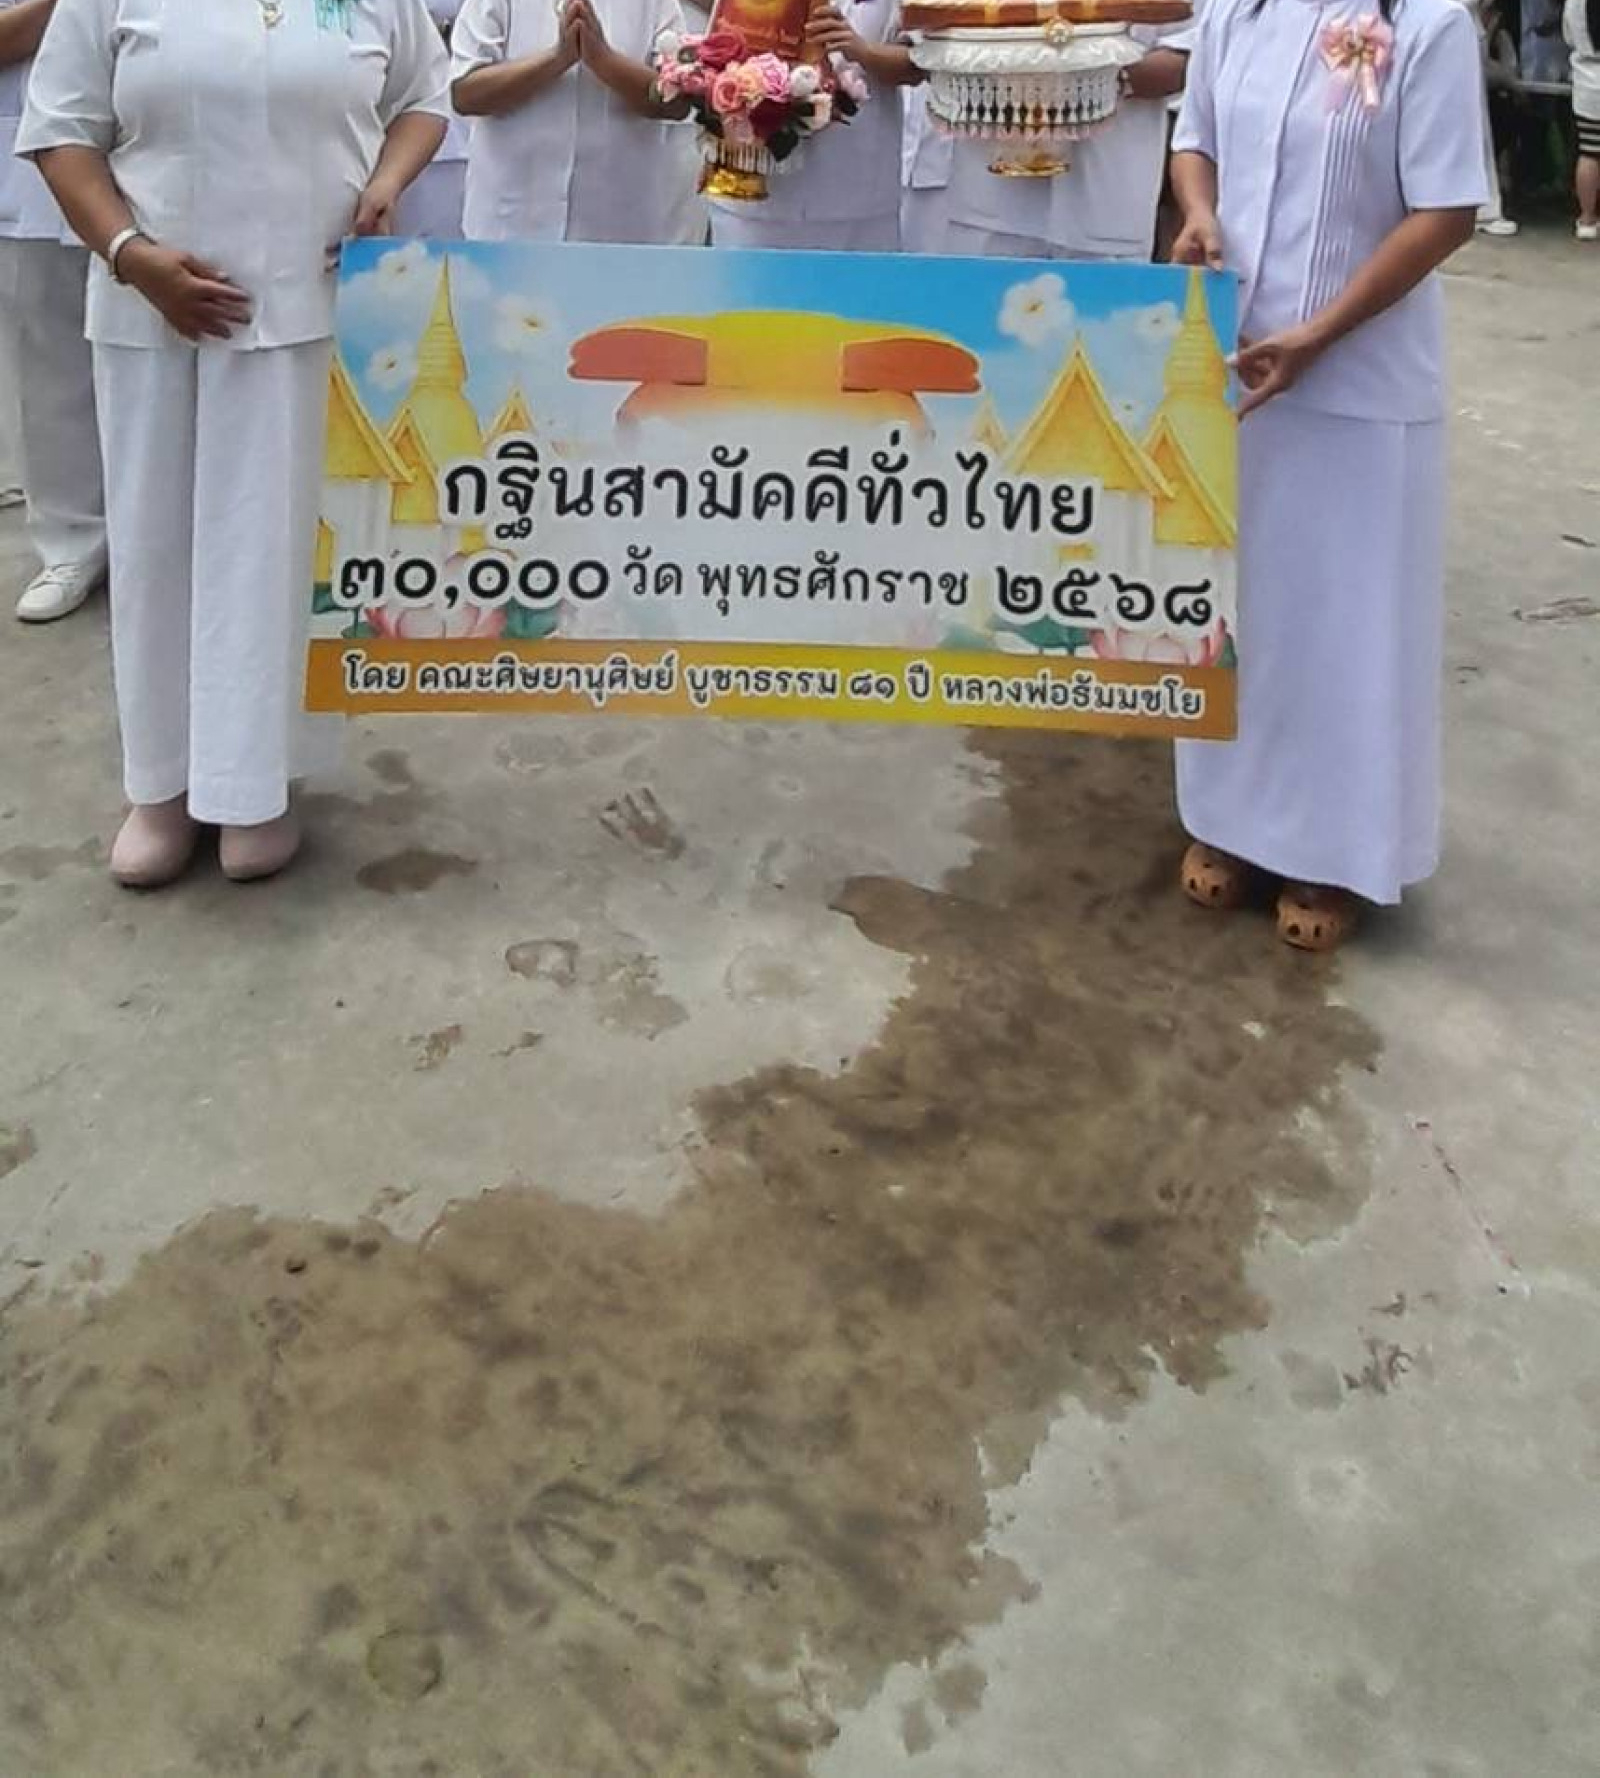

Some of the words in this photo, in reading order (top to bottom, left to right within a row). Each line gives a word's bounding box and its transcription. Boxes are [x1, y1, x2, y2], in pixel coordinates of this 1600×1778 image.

[445, 429, 1094, 540] กฐินสามัคคีทั่วไทย
[340, 557, 610, 610] ๓๐,๐๐๐
[623, 544, 682, 596] วัด
[698, 550, 969, 616] พุทธศักราช
[996, 566, 1213, 627] ๒๕๖๘
[345, 653, 406, 690] โดย
[419, 653, 676, 703] คณะศิษยานุศิษย์
[687, 667, 837, 705] บูชาธรรม
[850, 673, 895, 699] ๘๑
[907, 663, 930, 699] ปี
[942, 672, 1201, 715] หลวงพ่อธัมมชโย
